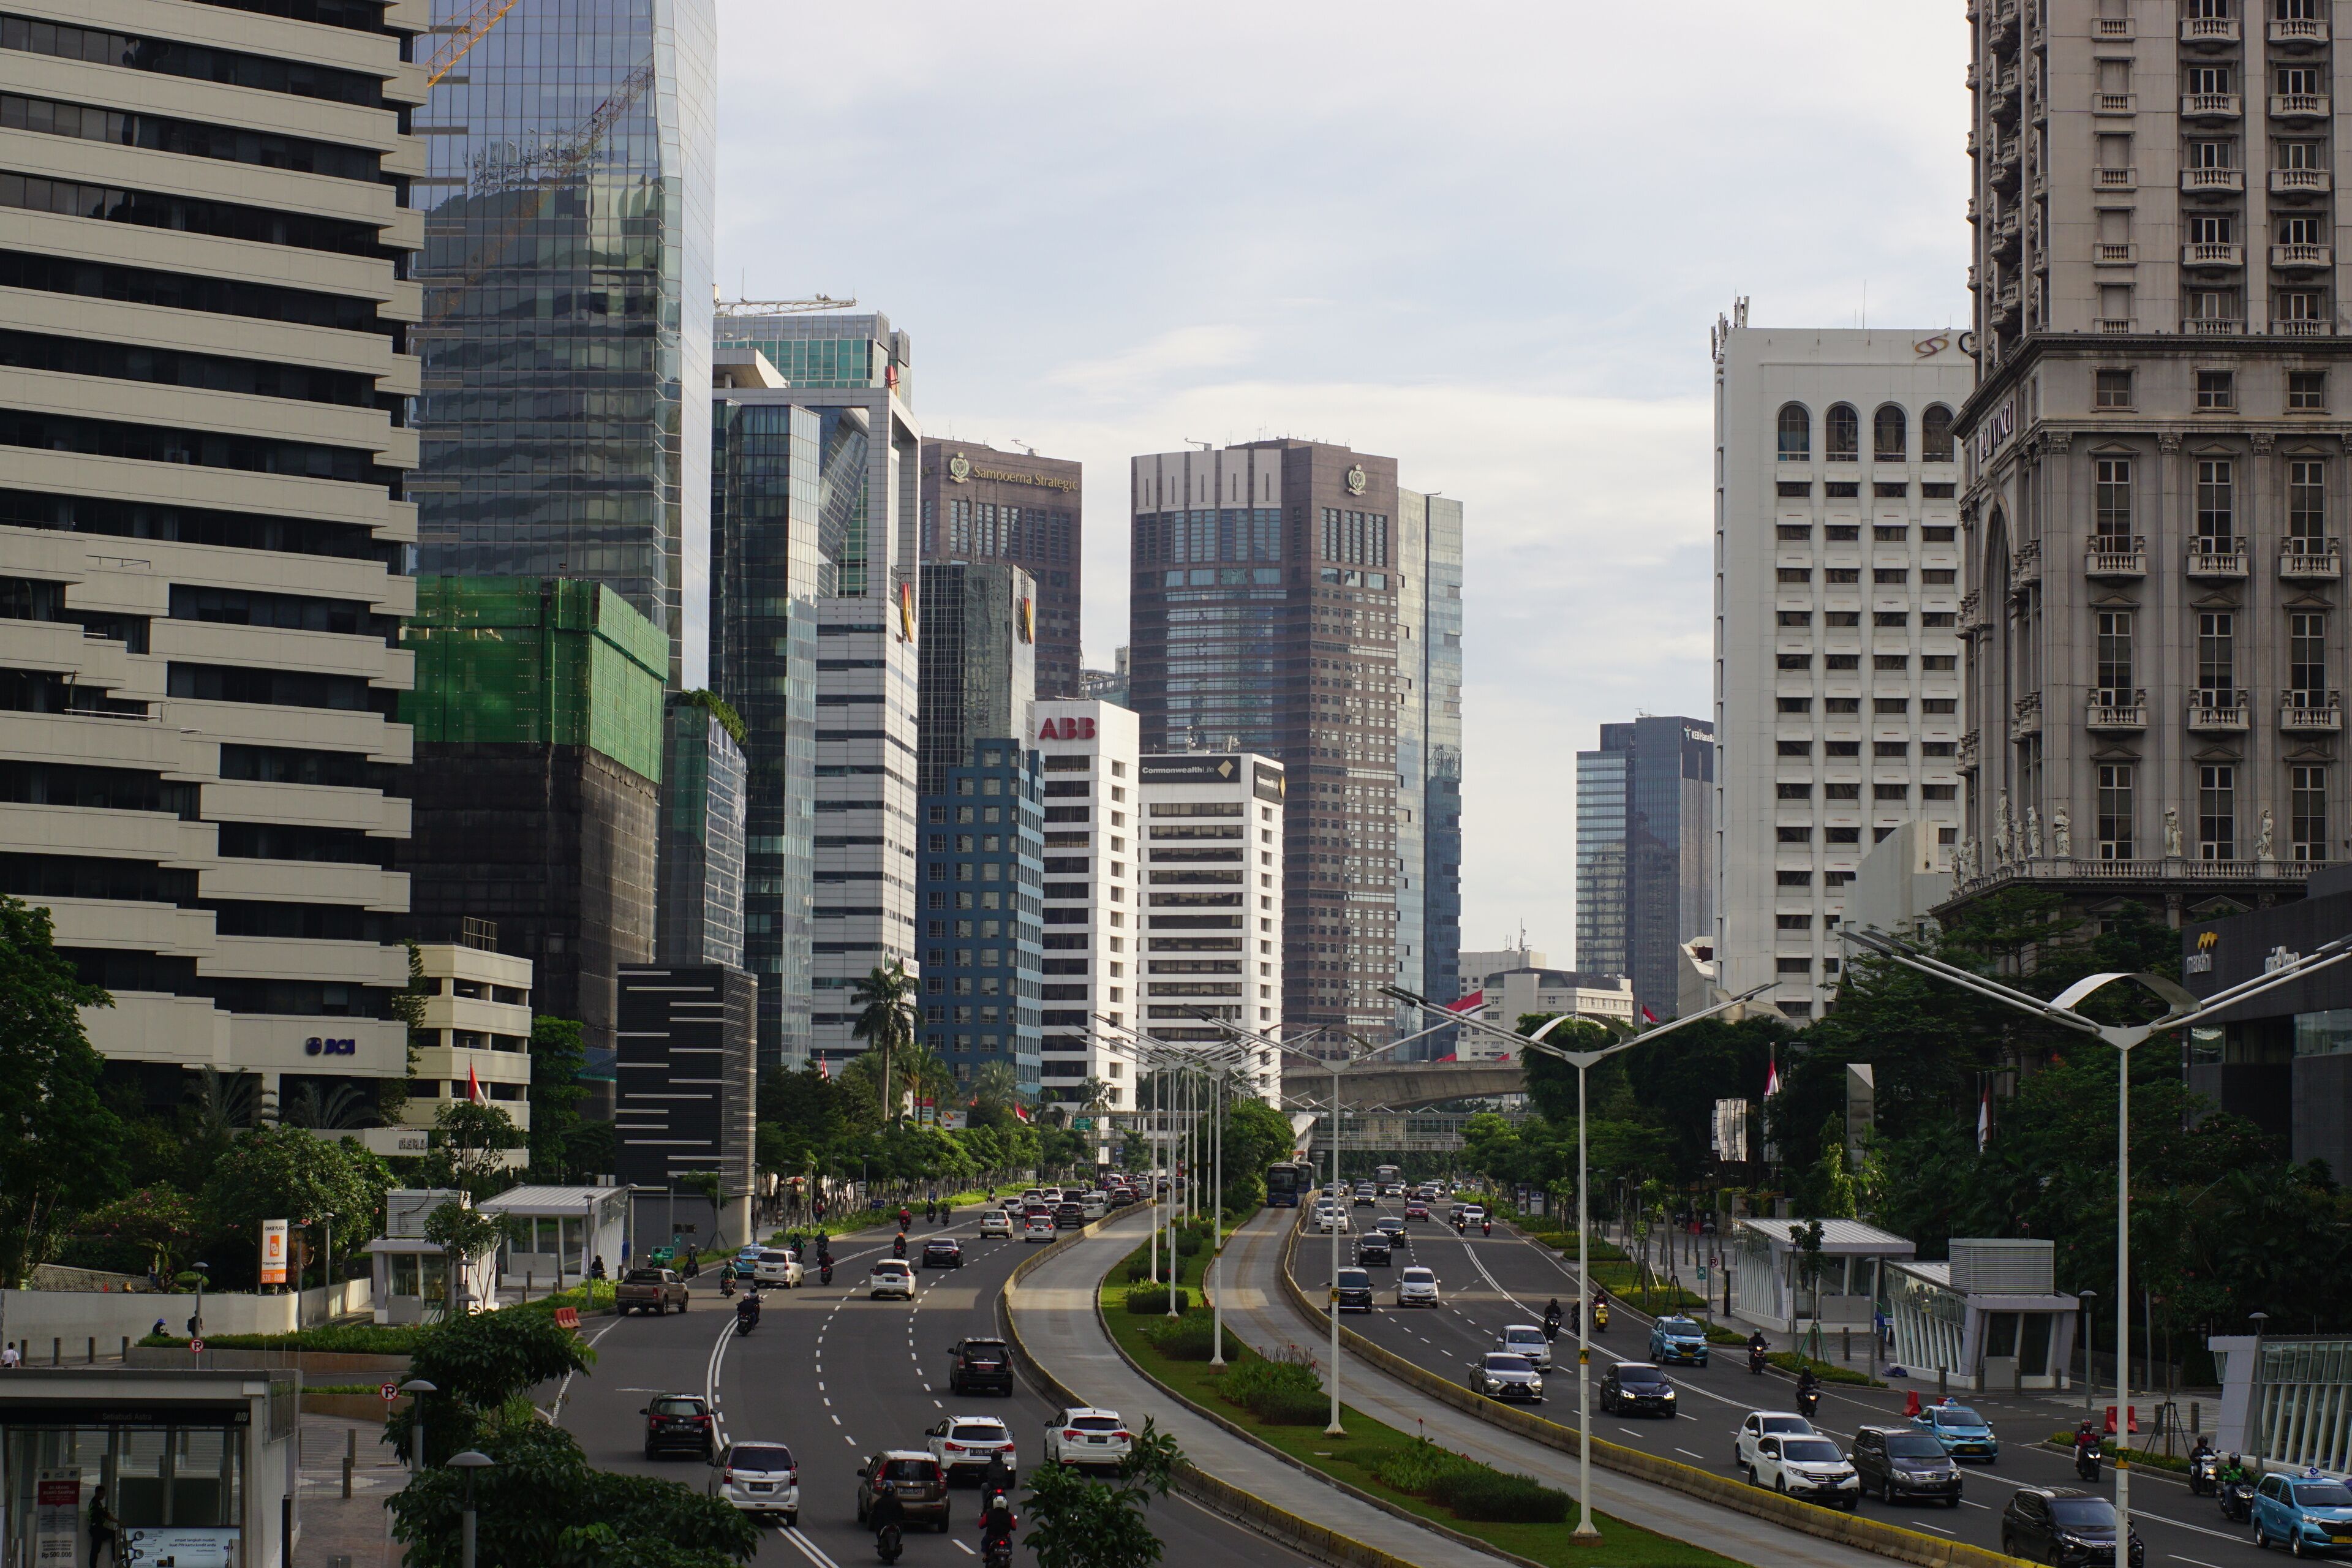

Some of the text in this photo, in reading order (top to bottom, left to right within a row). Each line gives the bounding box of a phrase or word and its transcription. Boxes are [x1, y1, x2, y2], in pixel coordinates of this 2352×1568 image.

[1980, 401, 2013, 463] DA VINCI
[974, 466, 1078, 492] Sampoerna Strategic
[1038, 717, 1095, 740] ABB
[1142, 766, 1215, 774] CommonwealthLife
[324, 1038, 355, 1055] BCA
